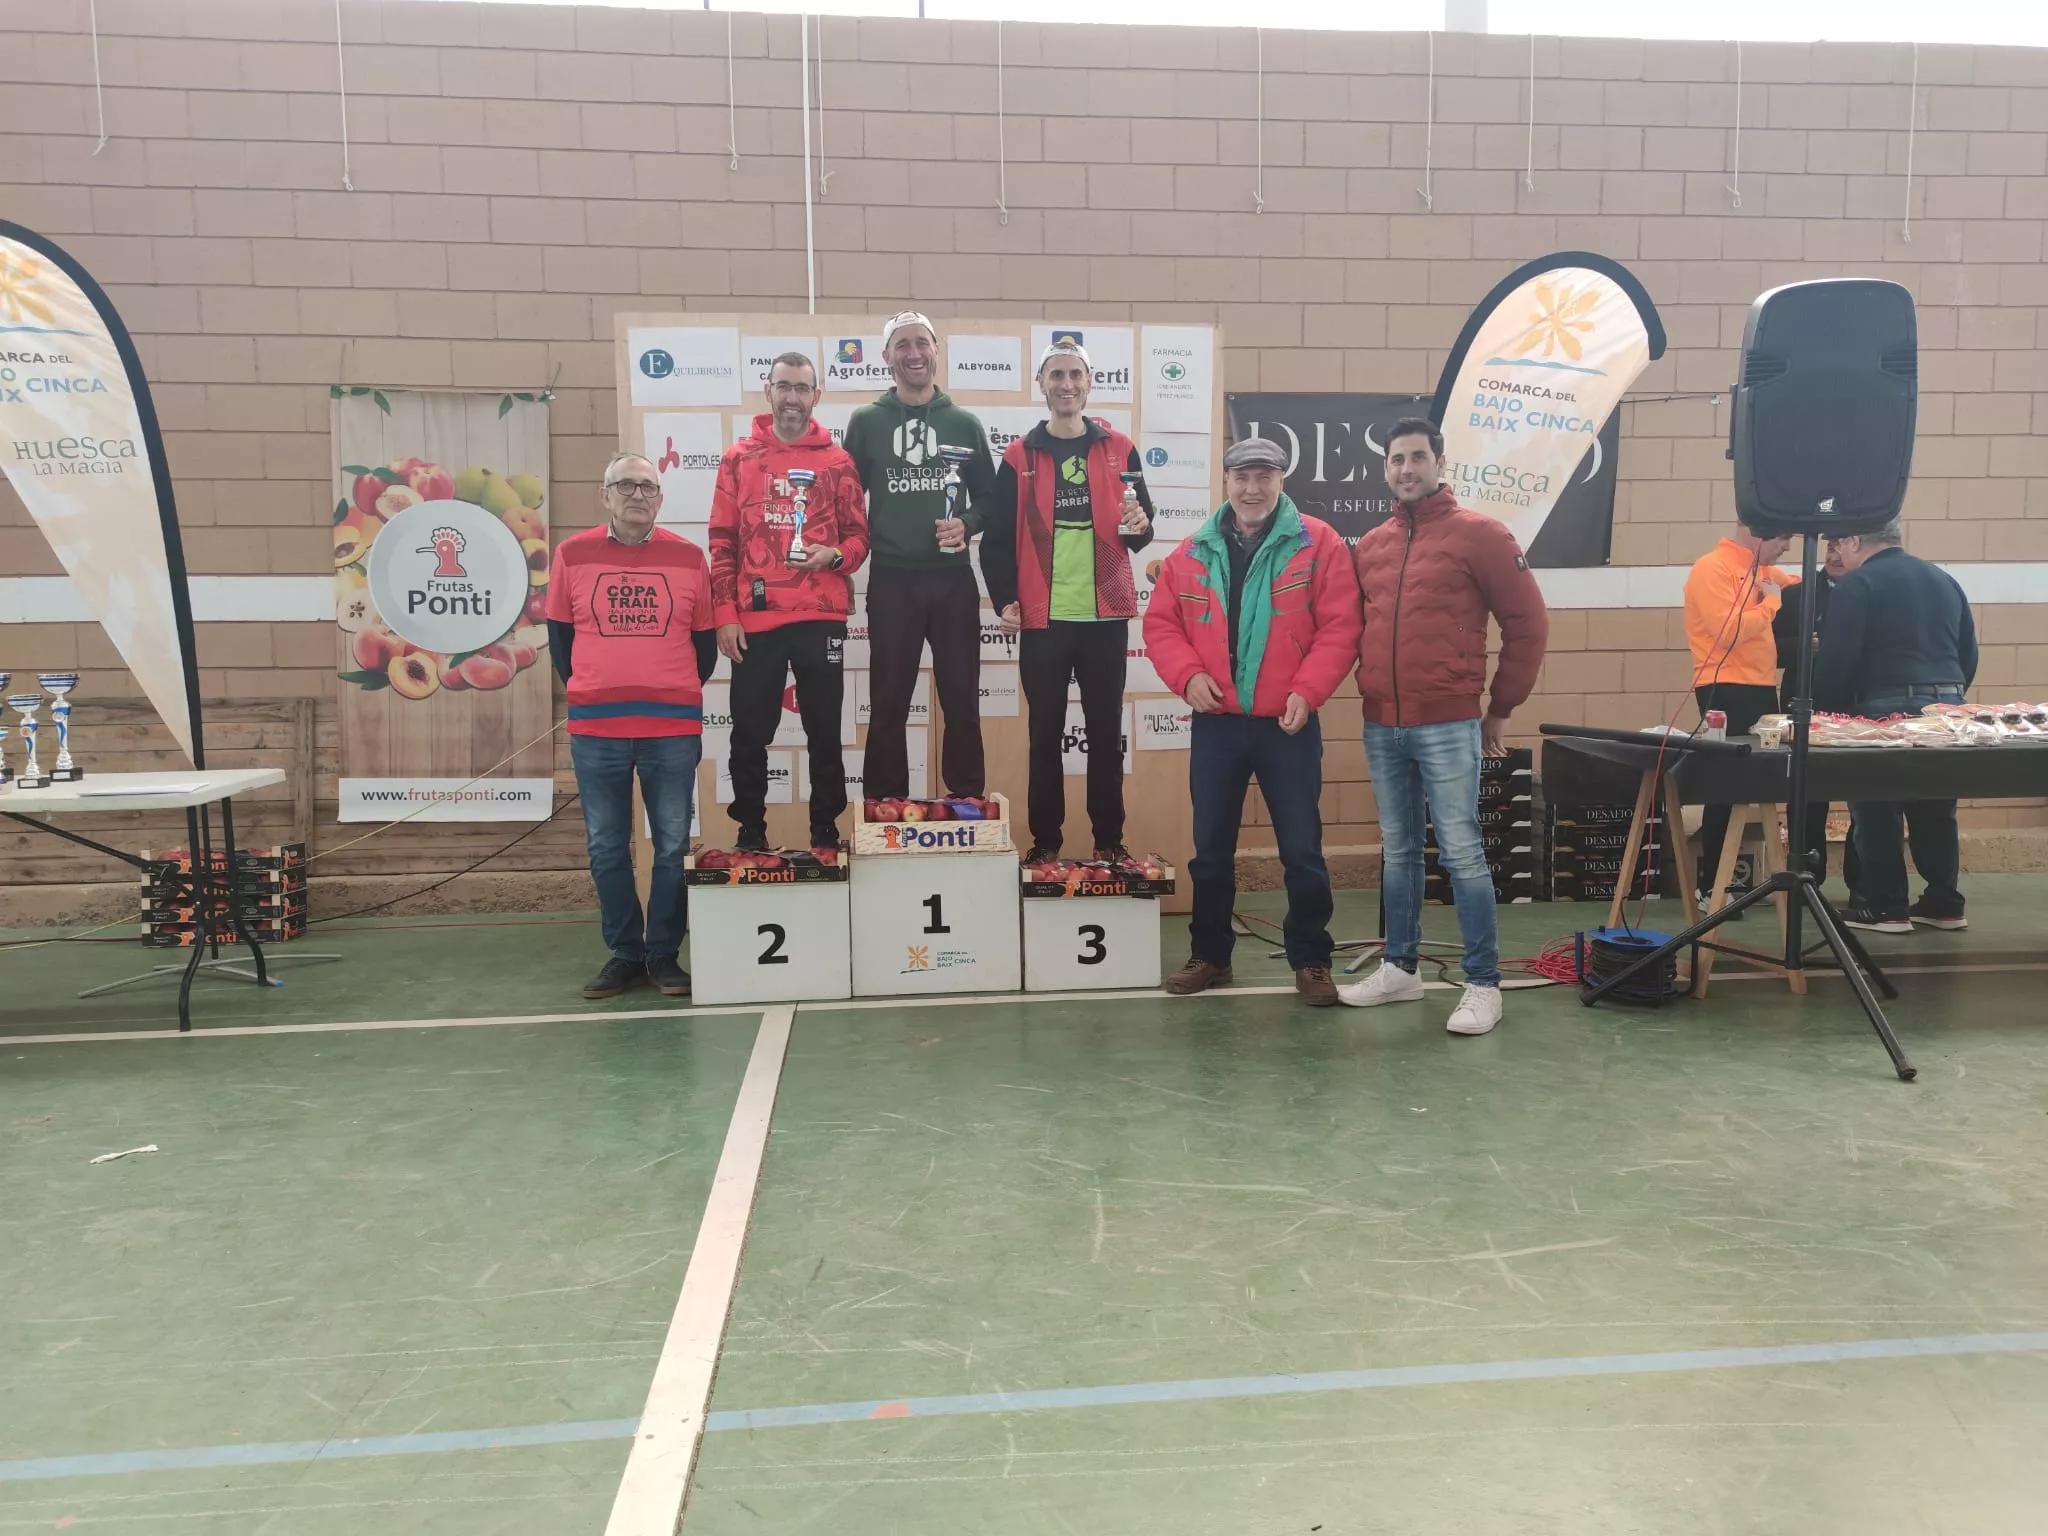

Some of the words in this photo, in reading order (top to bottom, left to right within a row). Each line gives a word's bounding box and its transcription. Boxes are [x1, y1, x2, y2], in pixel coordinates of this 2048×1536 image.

[49, 355, 72, 364] DEL
[1153, 348, 1193, 357] FARMACIA
[958, 362, 1012, 372] ALBYOBRA
[26, 378, 108, 393] CINCA
[1478, 378, 1551, 399] COMARCA
[1556, 392, 1577, 402] DEL
[1473, 392, 1524, 414] BAJO
[1469, 412, 1520, 433] BAIX
[1526, 411, 1595, 434] CINCA
[12, 436, 138, 460] Huesca
[887, 467, 900, 479] EL
[903, 467, 933, 479] RETO
[1068, 486, 1090, 497] RETO
[1159, 507, 1207, 519] agrostock
[1332, 500, 1394, 513] ESFUE
[427, 580, 473, 593] Frutas
[607, 585, 658, 598] COPA
[408, 589, 492, 616] Ponti
[608, 597, 659, 609] TRAIL
[608, 614, 658, 624] CINCA
[361, 788, 532, 804] www.frutasponti.com
[906, 825, 976, 848] Ponti
[747, 868, 796, 883] Ponti
[1082, 881, 1126, 895] Ponti
[922, 893, 951, 934] 1
[757, 923, 789, 965] 2
[1077, 924, 1107, 965] 3
